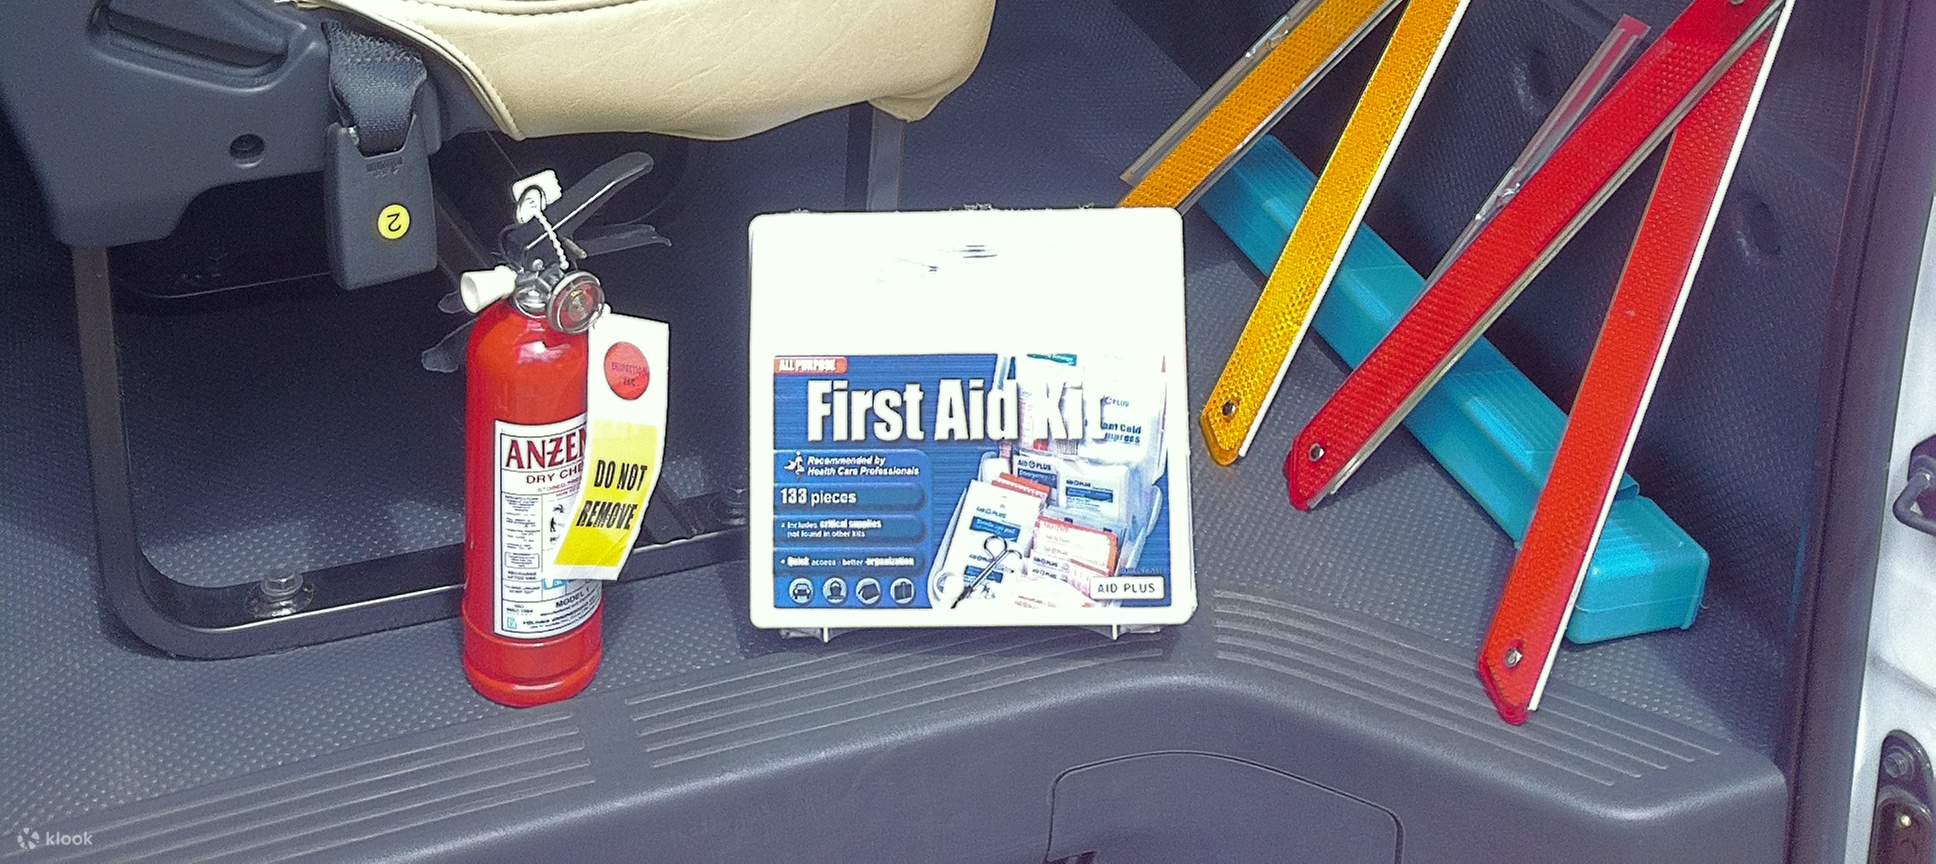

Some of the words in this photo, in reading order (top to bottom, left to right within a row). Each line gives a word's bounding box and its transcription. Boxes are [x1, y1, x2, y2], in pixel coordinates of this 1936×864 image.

[387, 213, 402, 232] 2
[807, 379, 925, 441] First
[934, 378, 1018, 440] Aid
[807, 456, 873, 466] Recommended
[874, 456, 886, 468] by
[594, 459, 616, 488] DO
[617, 462, 648, 491] NOT
[807, 466, 836, 476] Health
[837, 466, 859, 476] Care
[859, 466, 920, 476] Professionals
[526, 473, 556, 484] DRY
[780, 488, 808, 504] 133
[810, 490, 857, 507] pieces
[576, 500, 639, 530] REMOVE
[800, 530, 822, 538] found
[831, 530, 850, 538] other
[811, 559, 836, 567] access
[842, 557, 864, 566] better
[1097, 583, 1118, 593] AID
[1123, 583, 1156, 593] PLUS
[556, 591, 585, 608] MODEL
